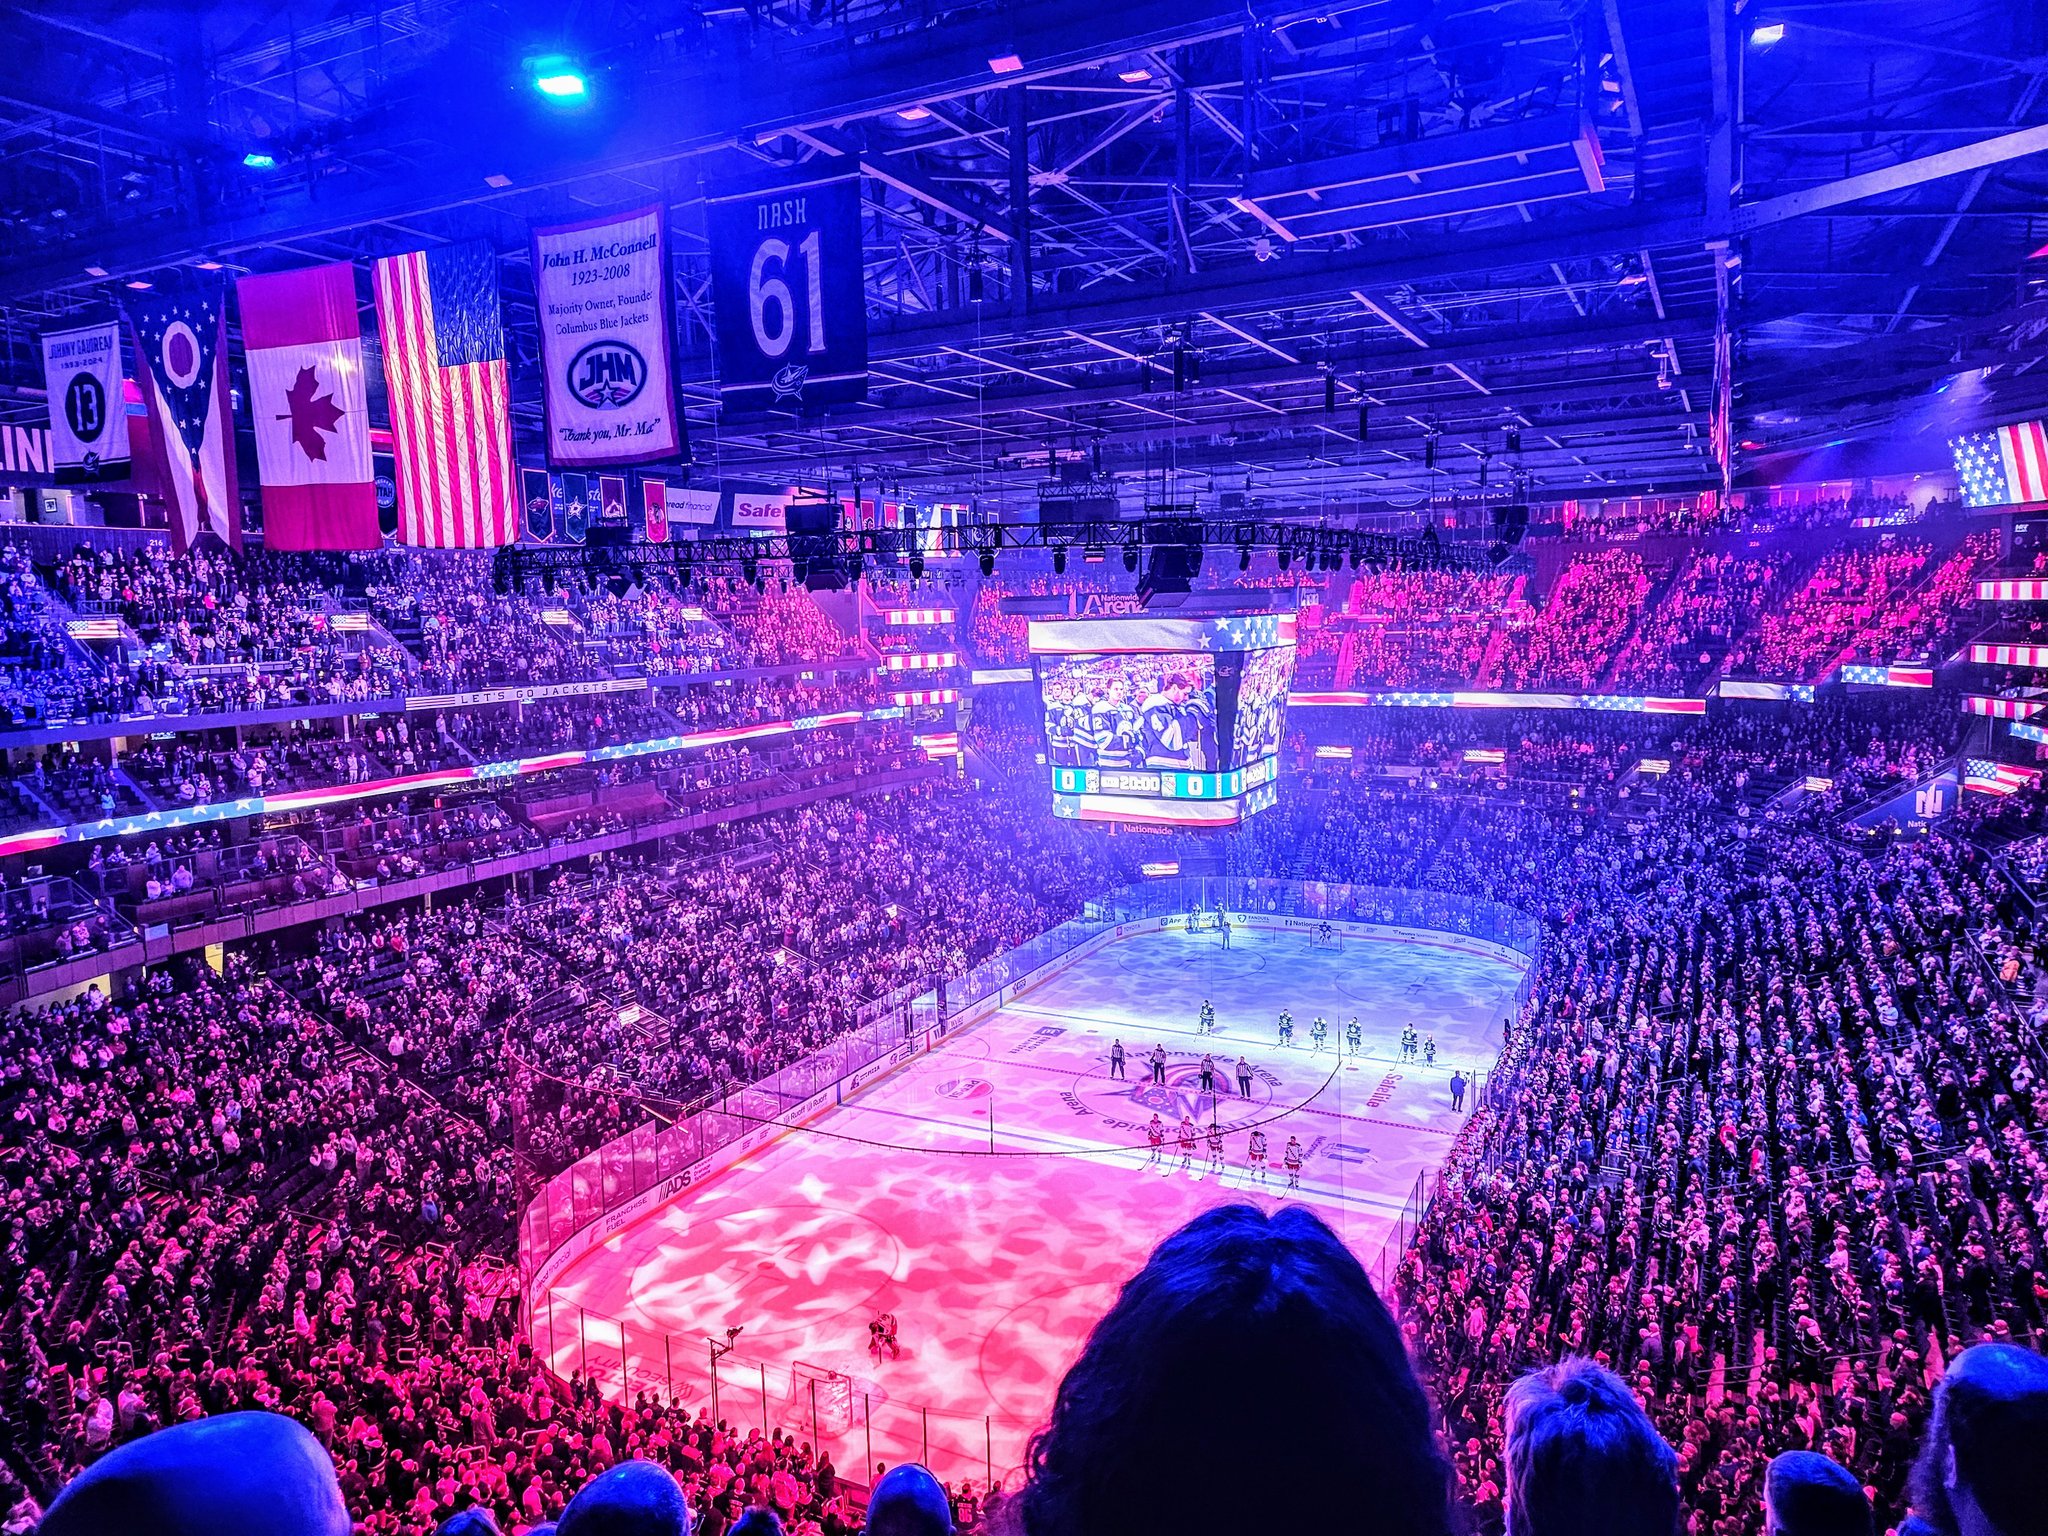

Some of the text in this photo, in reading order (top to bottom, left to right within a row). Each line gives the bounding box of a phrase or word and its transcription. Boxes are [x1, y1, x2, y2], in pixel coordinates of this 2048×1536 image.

[757, 198, 807, 230] NASH
[542, 233, 657, 272] John H. McConnell
[571, 263, 631, 287] 1923-2008
[749, 230, 827, 357] 61
[547, 302, 583, 317] Majority
[584, 299, 616, 311] Owner,
[555, 313, 650, 335] Columbus Blue Jackets
[48, 340, 76, 360] JOHNNY
[60, 357, 104, 370] 1993-2024
[578, 352, 638, 391] JHM
[74, 383, 99, 432] 13
[591, 430, 612, 445] you,
[613, 424, 632, 438] Mr.
[666, 500, 712, 511] read financial
[1101, 594, 1140, 602] Nationwid
[461, 682, 609, 704] LET'S GO JACKETS
[1061, 770, 1075, 790] 0
[1120, 775, 1160, 792] 20:00
[1187, 775, 1203, 796] 0
[1123, 824, 1174, 836] Nationwide
[1366, 1073, 1404, 1108] Safelite
[1059, 1090, 1094, 1116] Arena
[665, 1170, 691, 1199] ADS
[605, 1196, 648, 1226] FRANCHISE
[606, 1218, 626, 1233] FUEL
[579, 1362, 658, 1396] VECTO
